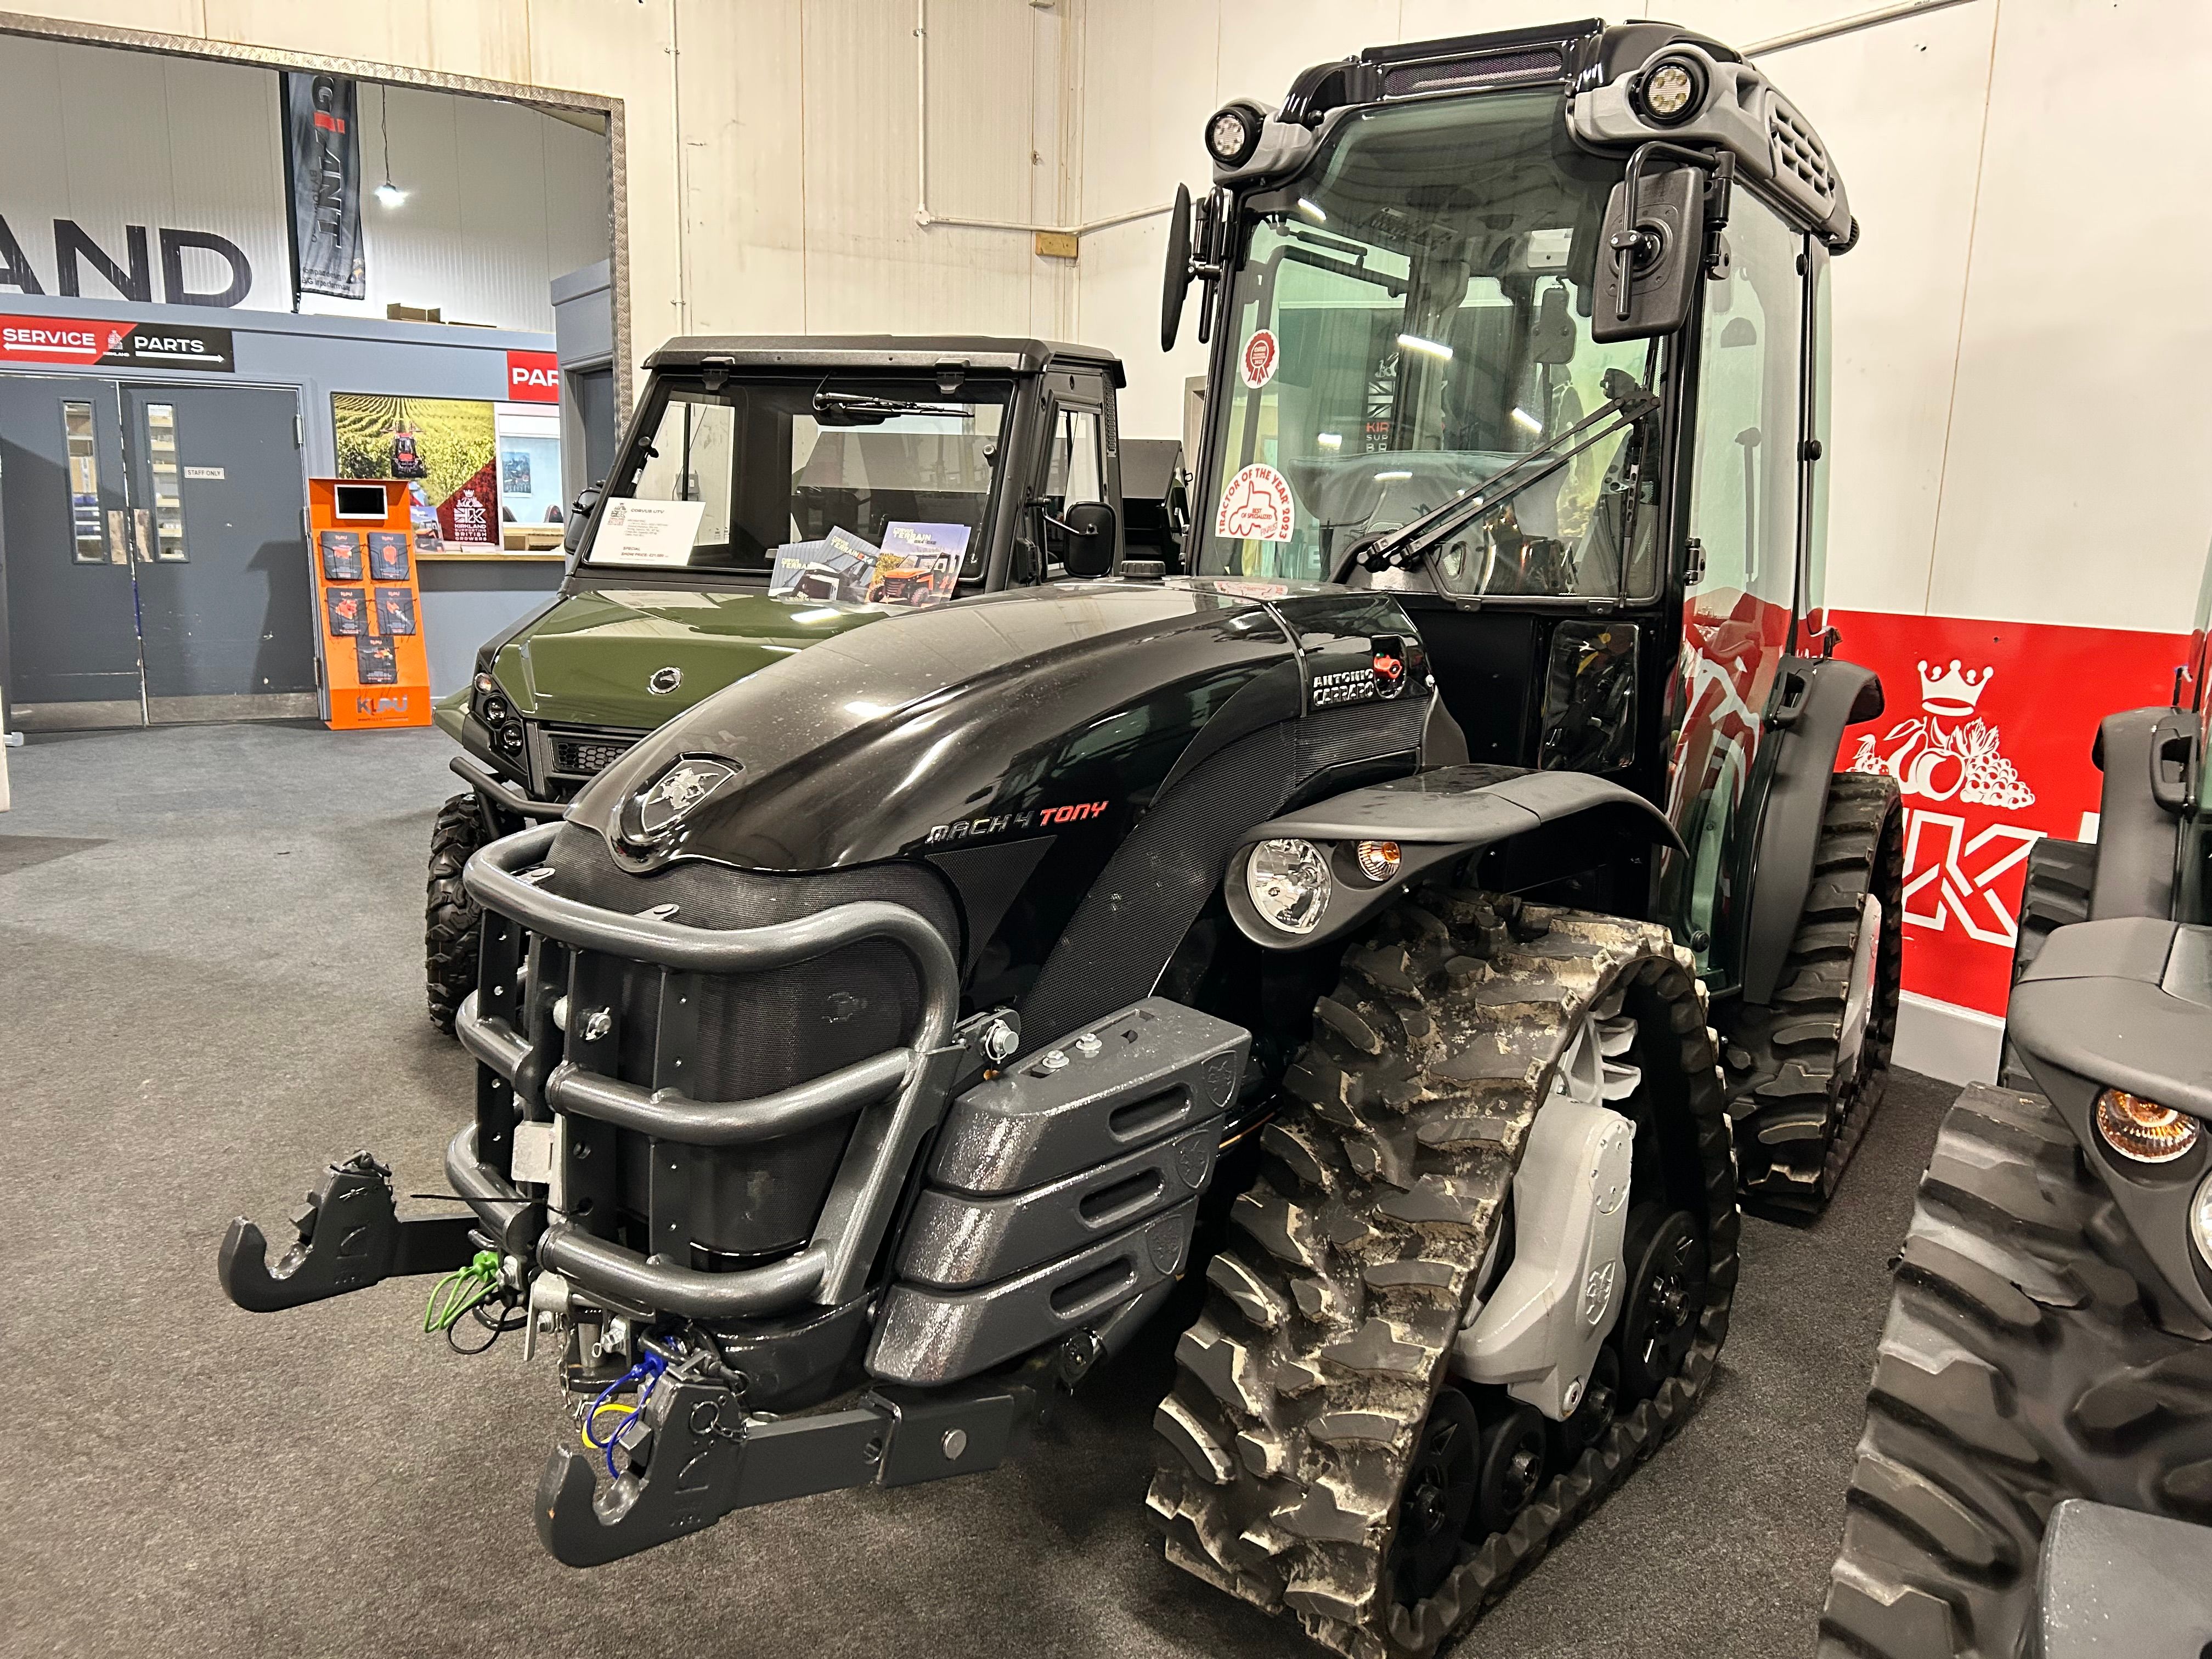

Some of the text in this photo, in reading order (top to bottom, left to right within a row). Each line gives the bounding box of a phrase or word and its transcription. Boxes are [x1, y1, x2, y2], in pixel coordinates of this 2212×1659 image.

[3, 328, 95, 346] SERVICE
[134, 336, 205, 353] PARTS
[1219, 468, 1291, 539] TRACTOR OF THE YEAR 2023
[893, 532, 932, 541] TERRAIN
[1260, 522, 1278, 536] FINALIST
[831, 540, 860, 557] TERRAIN
[1313, 668, 1374, 688] ANTONIO
[1313, 681, 1374, 707] CARRARO
[924, 800, 1109, 844] MACH 4 TONY
